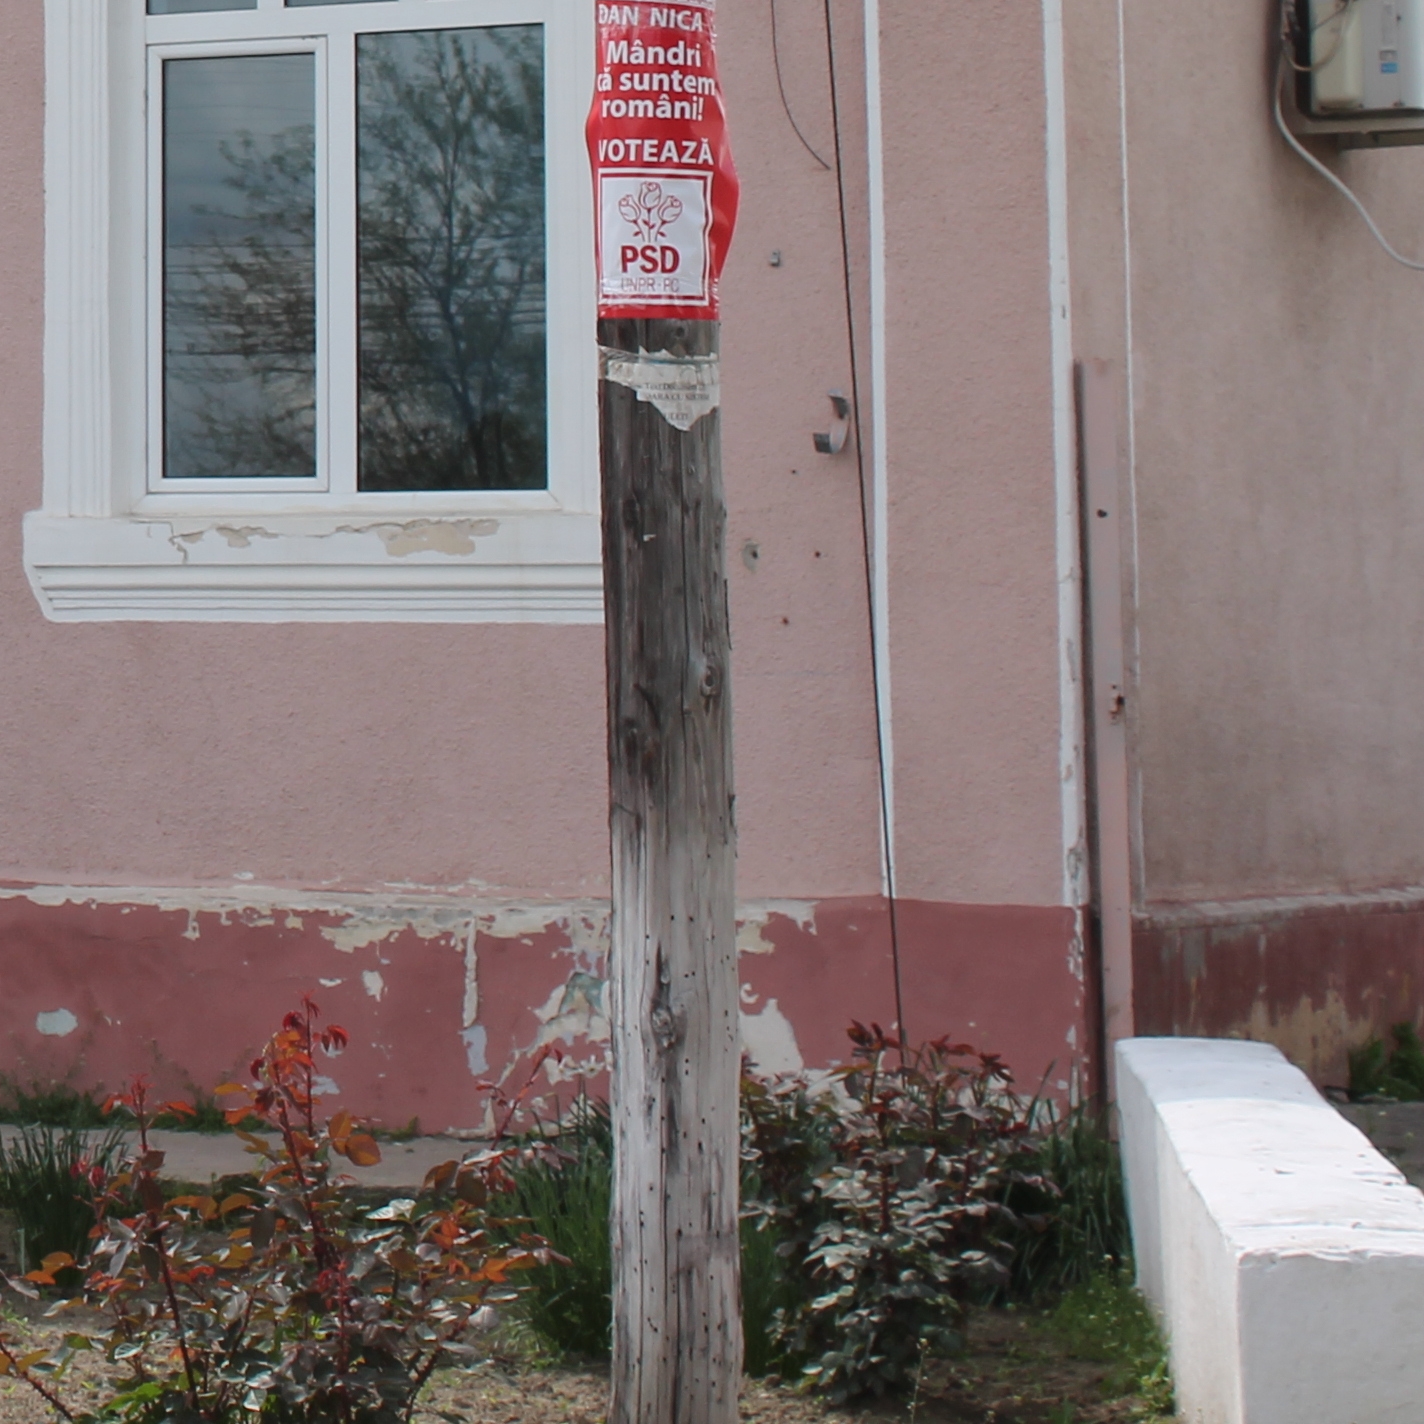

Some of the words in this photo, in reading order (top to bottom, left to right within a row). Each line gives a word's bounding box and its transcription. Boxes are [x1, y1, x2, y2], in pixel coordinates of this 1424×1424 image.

[598, 4, 640, 26] DAN
[650, 7, 703, 32] NICA
[606, 39, 702, 67] Mândri
[619, 69, 716, 96] suntem
[601, 93, 704, 121] români!
[598, 137, 714, 165] VOTEAZĂ
[619, 244, 680, 275] PSD
